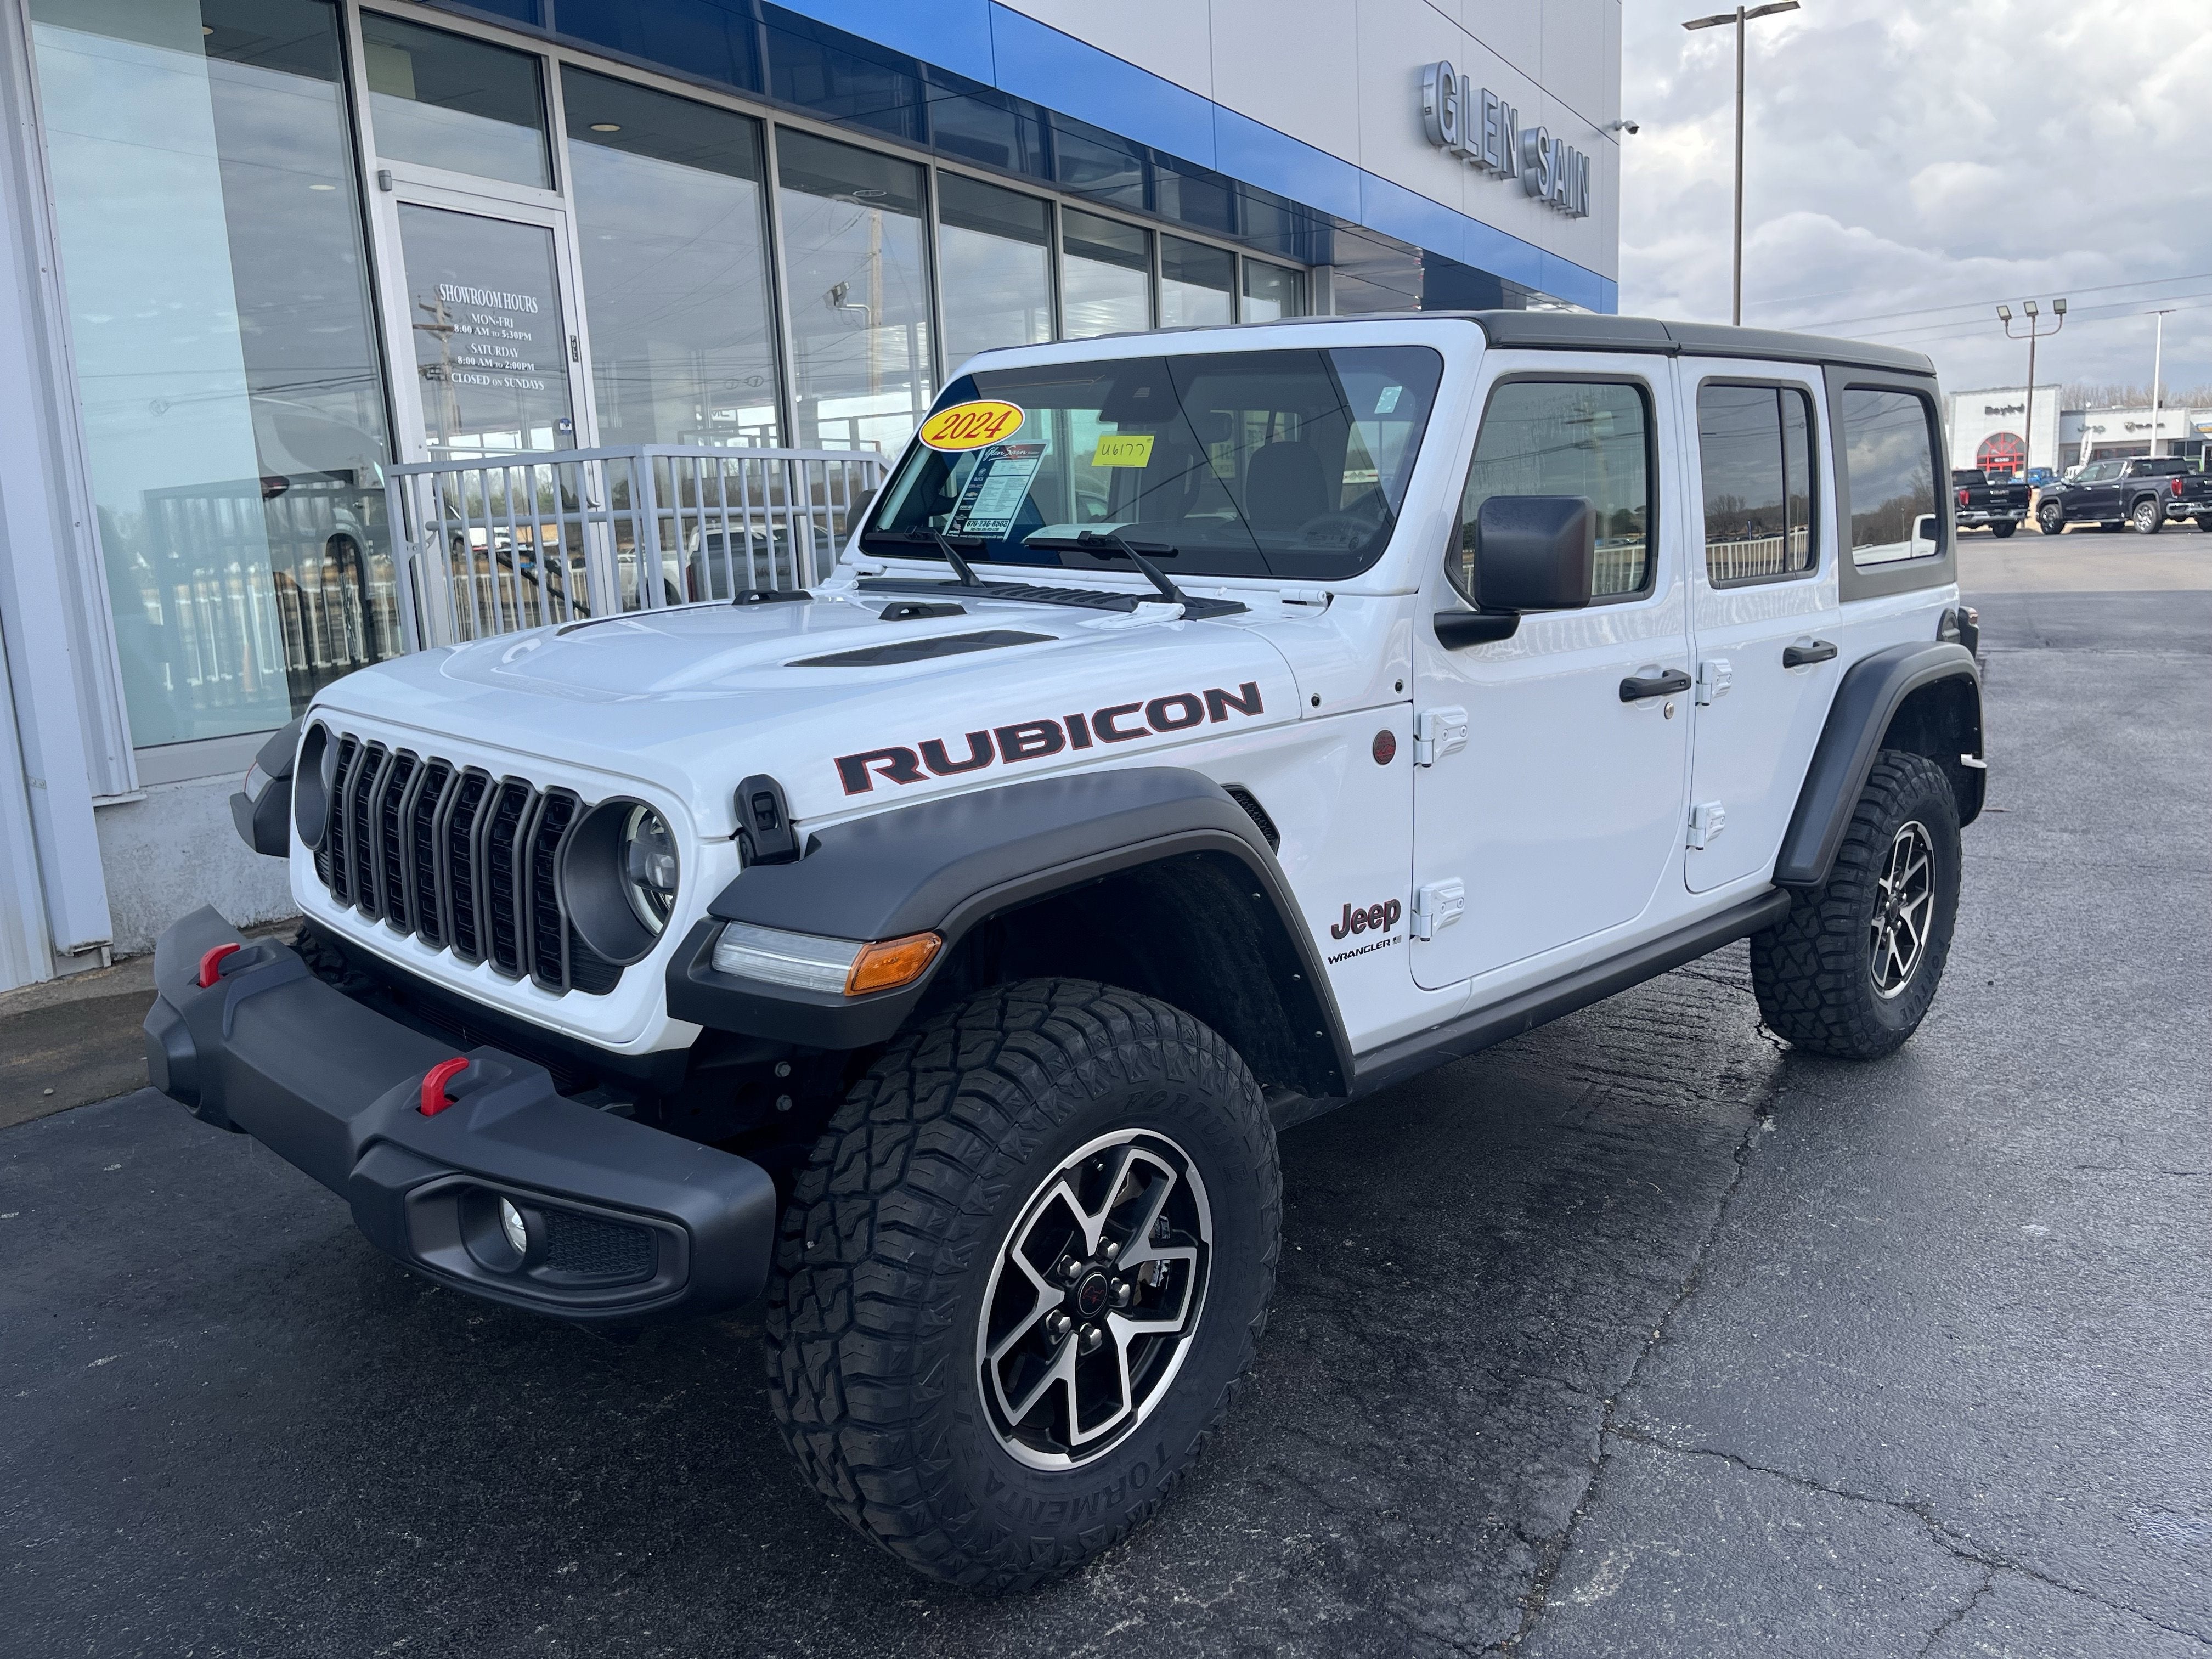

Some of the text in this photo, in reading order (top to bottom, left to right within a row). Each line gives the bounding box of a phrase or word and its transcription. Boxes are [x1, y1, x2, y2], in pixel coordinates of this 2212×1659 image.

[1423, 60, 1589, 217] GLEN SAIN
[439, 283, 538, 313] SHOWROOM HOURS
[471, 313, 514, 328] MON-FRI
[454, 324, 472, 334] 8:00
[474, 326, 490, 336] AM
[501, 330, 532, 341] 5:30PM
[471, 343, 520, 358] SATURDAY
[457, 356, 476, 365] 8:00
[477, 358, 493, 367] AM
[504, 360, 535, 371] 2:00PM
[451, 372, 490, 385] CLOSED
[504, 377, 545, 391] SUNDAYS
[931, 410, 1012, 441] 2024
[983, 445, 1028, 461] Glen Sain
[1102, 443, 1145, 456] U6177
[833, 681, 1265, 797] RUBICON
[1331, 899, 1401, 940] Jeep
[1327, 939, 1391, 964] WRANGLER
[984, 1442, 1172, 1527] TORMENTA
